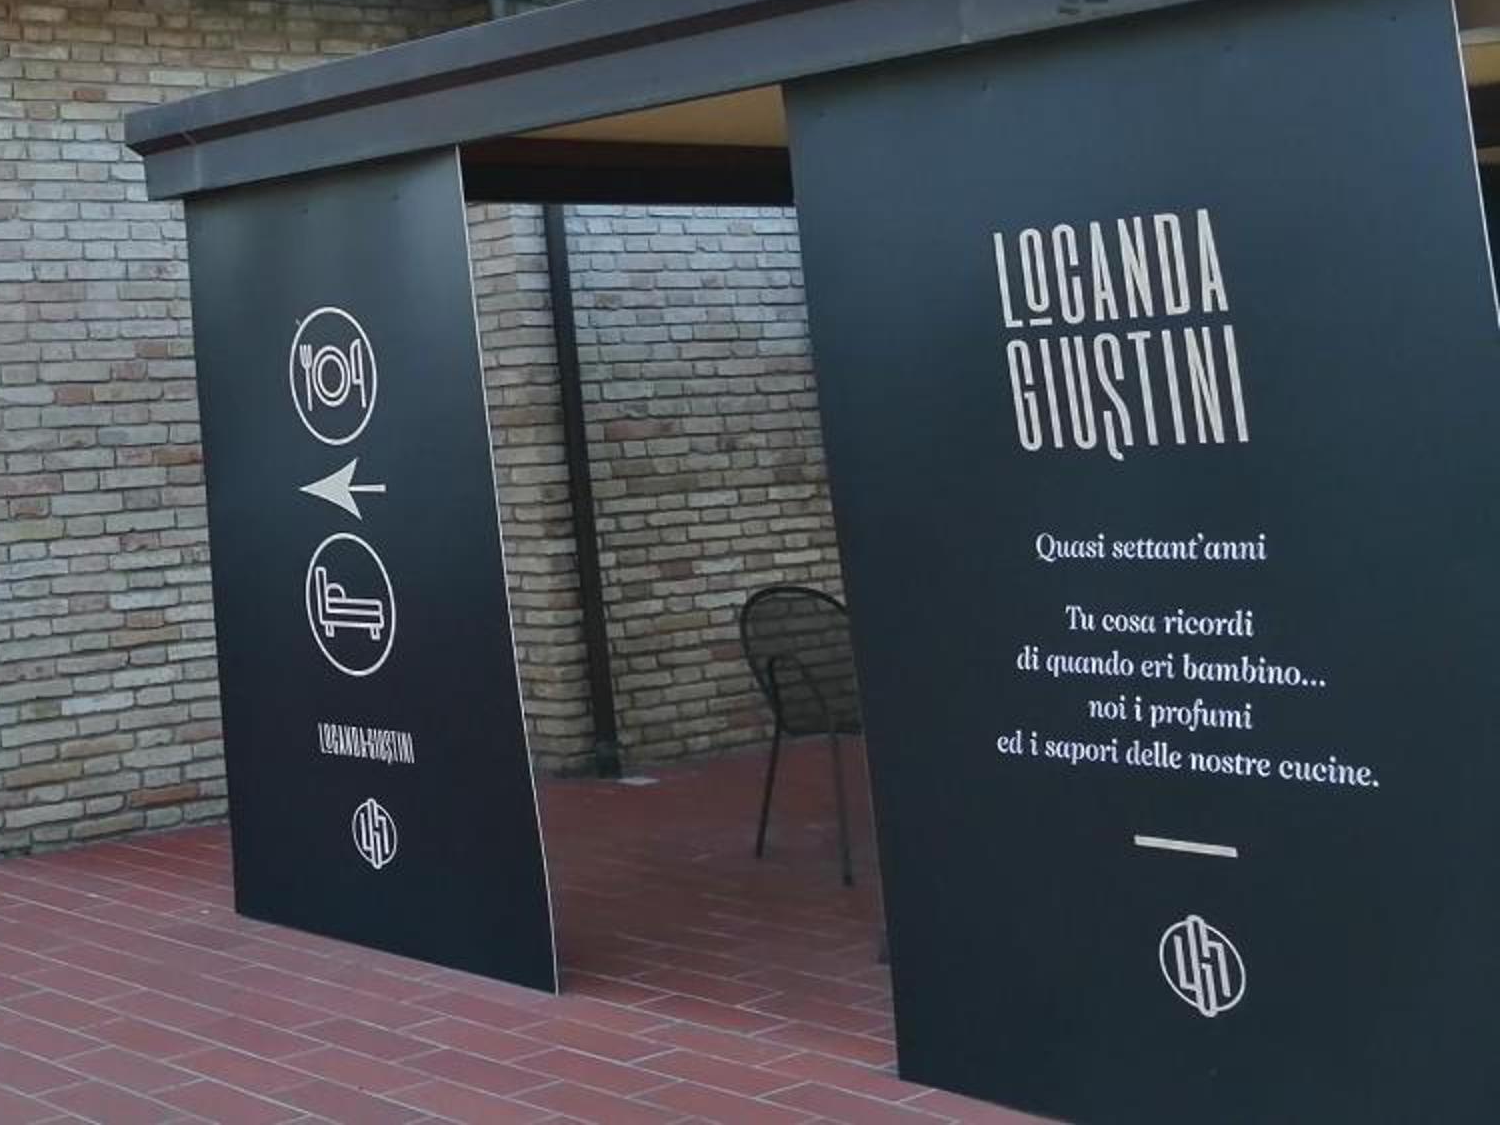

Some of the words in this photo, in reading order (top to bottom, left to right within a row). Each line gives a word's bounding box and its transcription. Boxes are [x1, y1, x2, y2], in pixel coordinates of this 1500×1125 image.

[992, 207, 1230, 330] LOCANDA
[1005, 324, 1250, 463] GIUSTINI
[1035, 532, 1107, 564] Quasi
[1111, 532, 1267, 561] settant'anni
[1064, 604, 1097, 632] Tu
[1101, 613, 1157, 634] cosa
[1163, 608, 1255, 638] ricordi
[1016, 644, 1041, 672] di
[1045, 649, 1135, 678] quando
[1140, 652, 1176, 680] eri
[1182, 652, 1327, 688] bambino...
[1087, 694, 1128, 721] noi
[1133, 695, 1144, 722] i
[1148, 697, 1253, 733] profumi
[996, 729, 1025, 756] ed
[1029, 730, 1039, 757] i
[1043, 737, 1120, 766] sapori
[1125, 739, 1183, 770] delle
[1187, 752, 1272, 778] nostre
[1277, 755, 1380, 788] cucine.
